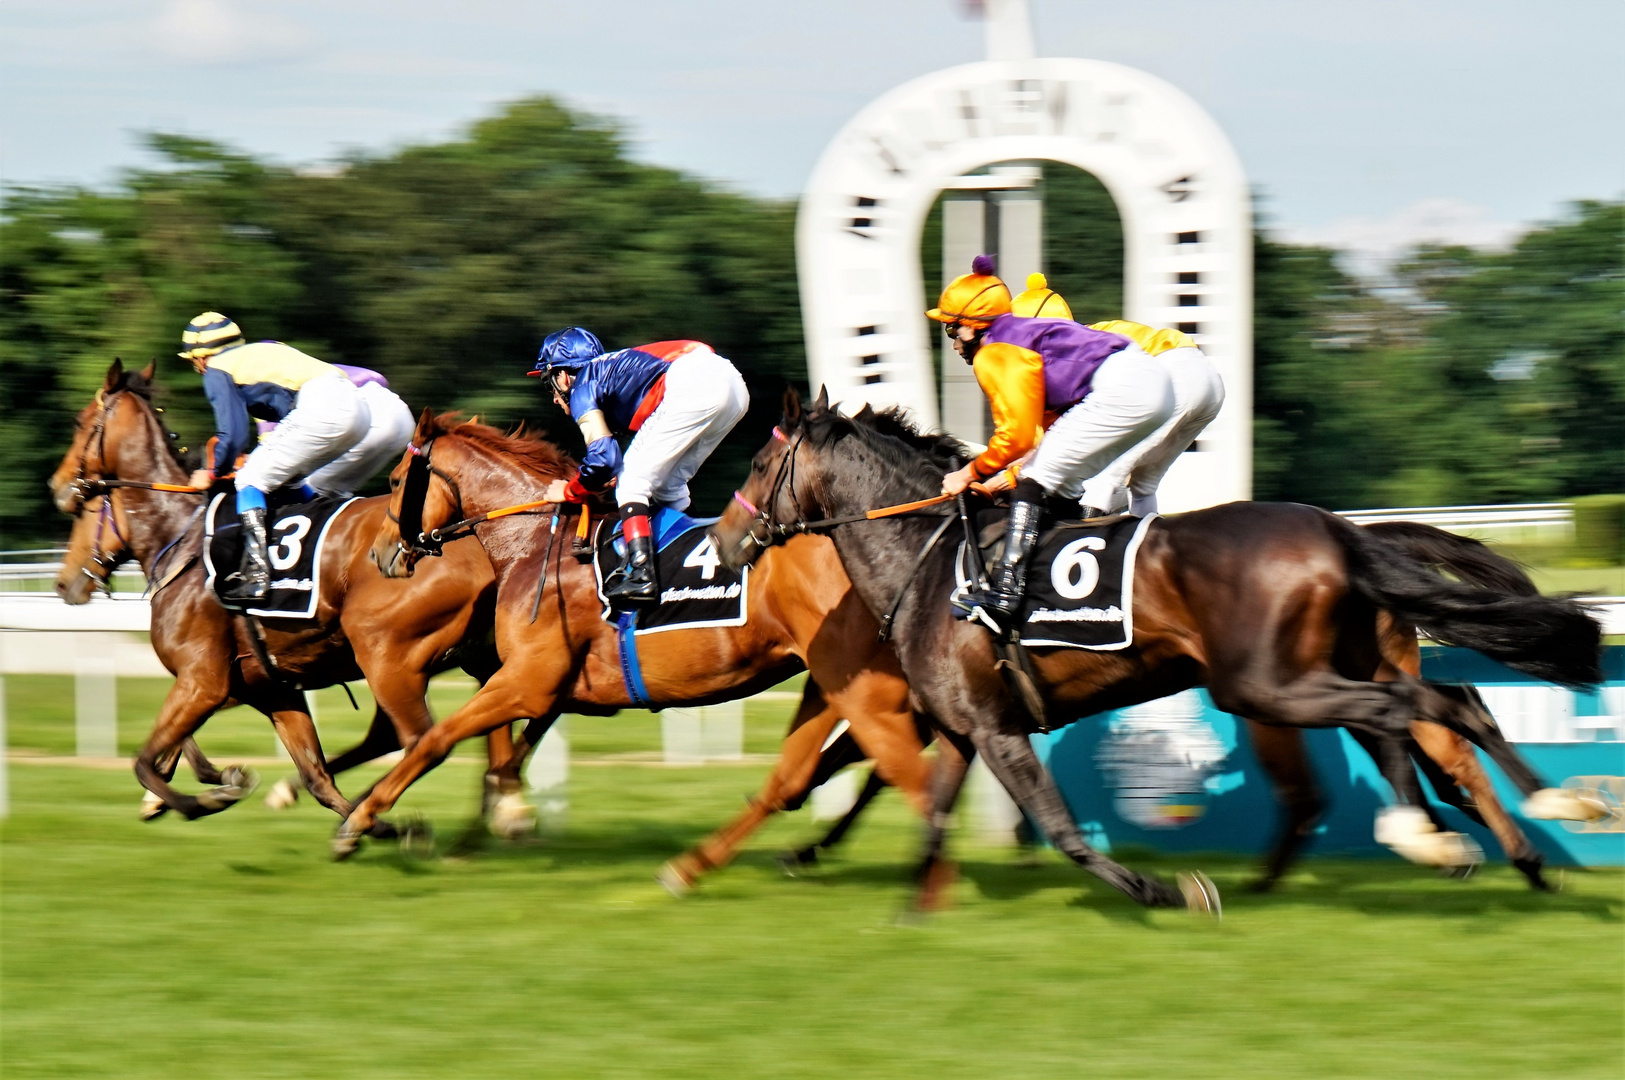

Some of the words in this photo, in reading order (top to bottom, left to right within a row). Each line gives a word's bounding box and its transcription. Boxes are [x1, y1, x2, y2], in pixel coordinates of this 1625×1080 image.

[268, 515, 312, 570] 3
[682, 534, 722, 580] 4
[1051, 536, 1107, 599] 6
